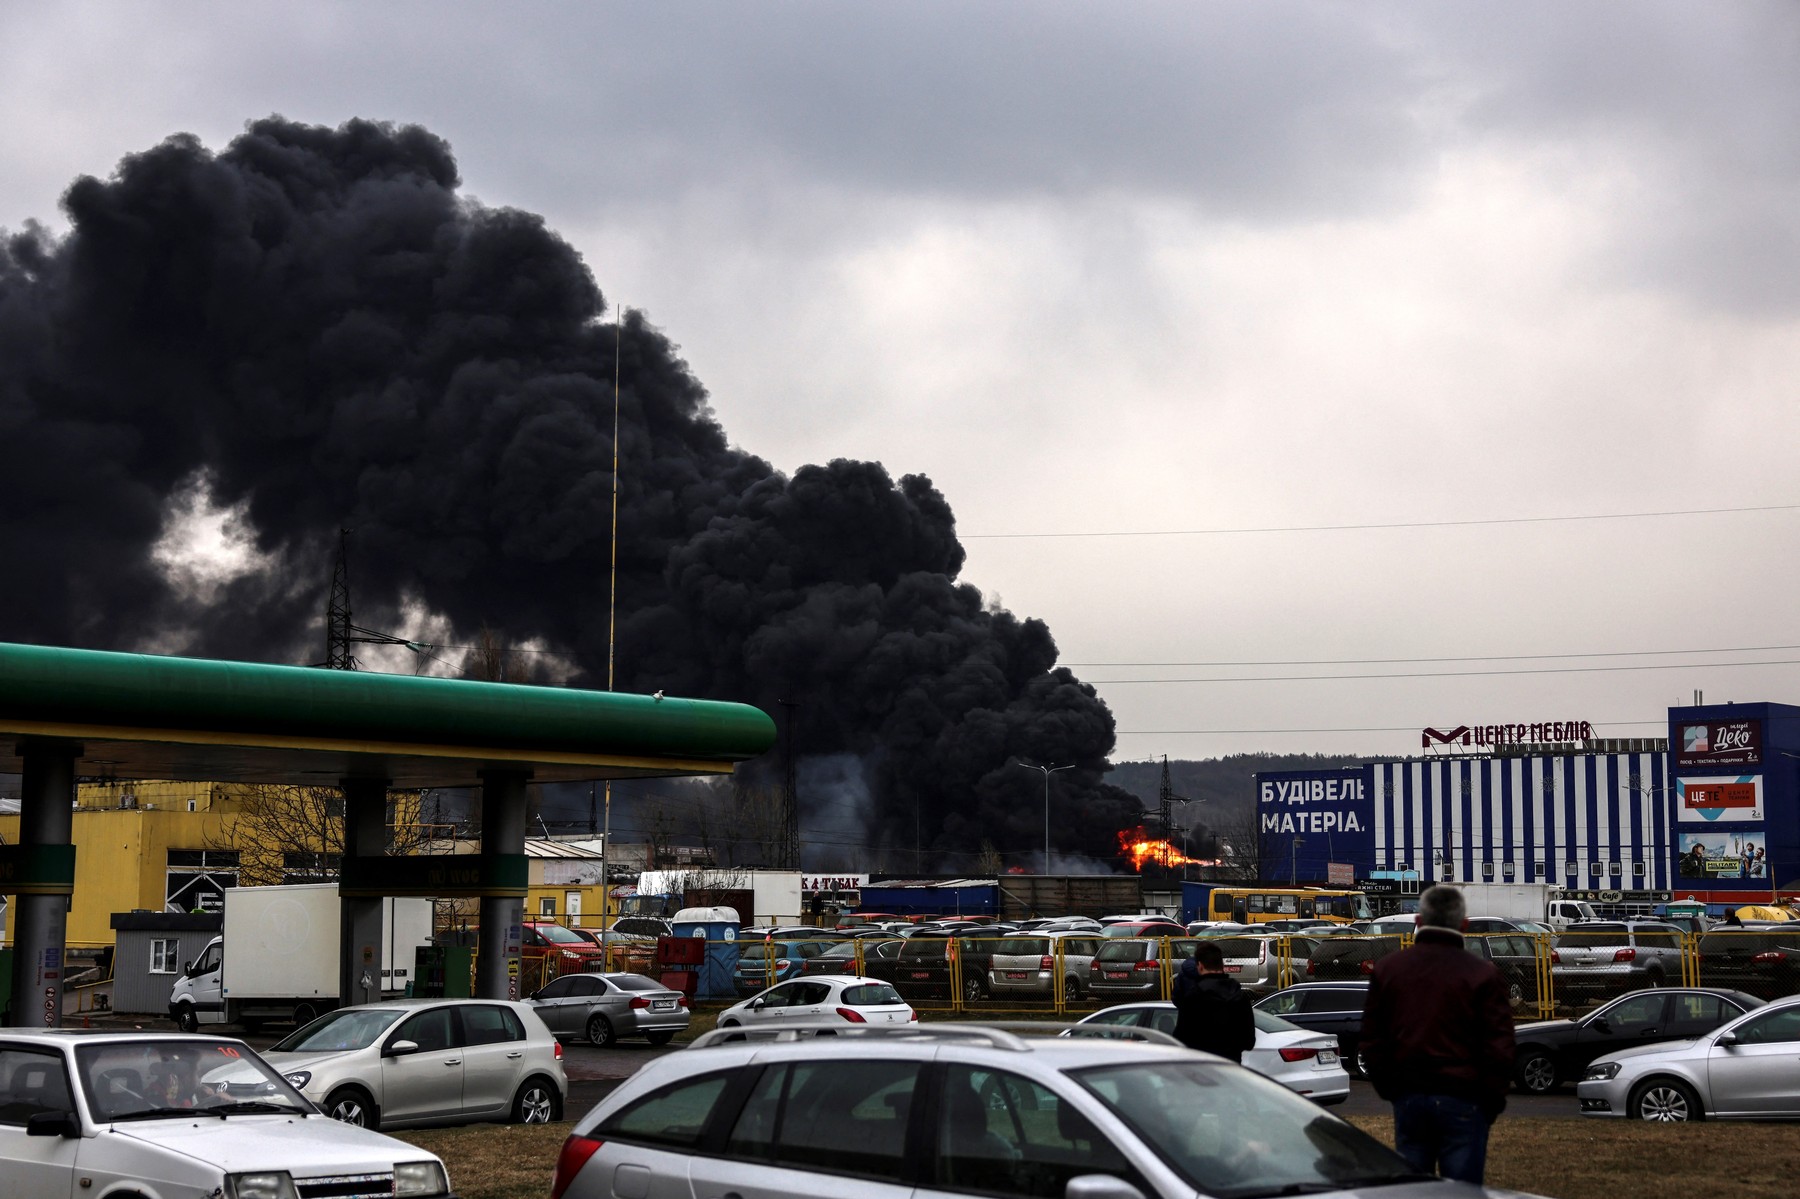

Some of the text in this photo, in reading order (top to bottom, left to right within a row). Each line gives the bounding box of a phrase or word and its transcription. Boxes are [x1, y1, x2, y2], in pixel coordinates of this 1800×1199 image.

[1474, 723, 1526, 747] ЦЕНТР
[1530, 720, 1591, 743] МЕБЛІВ
[1713, 726, 1750, 751] Деко
[1261, 810, 1365, 834] МАТЕРІА
[1602, 892, 1618, 901] Café
[217, 1046, 240, 1059] 10
